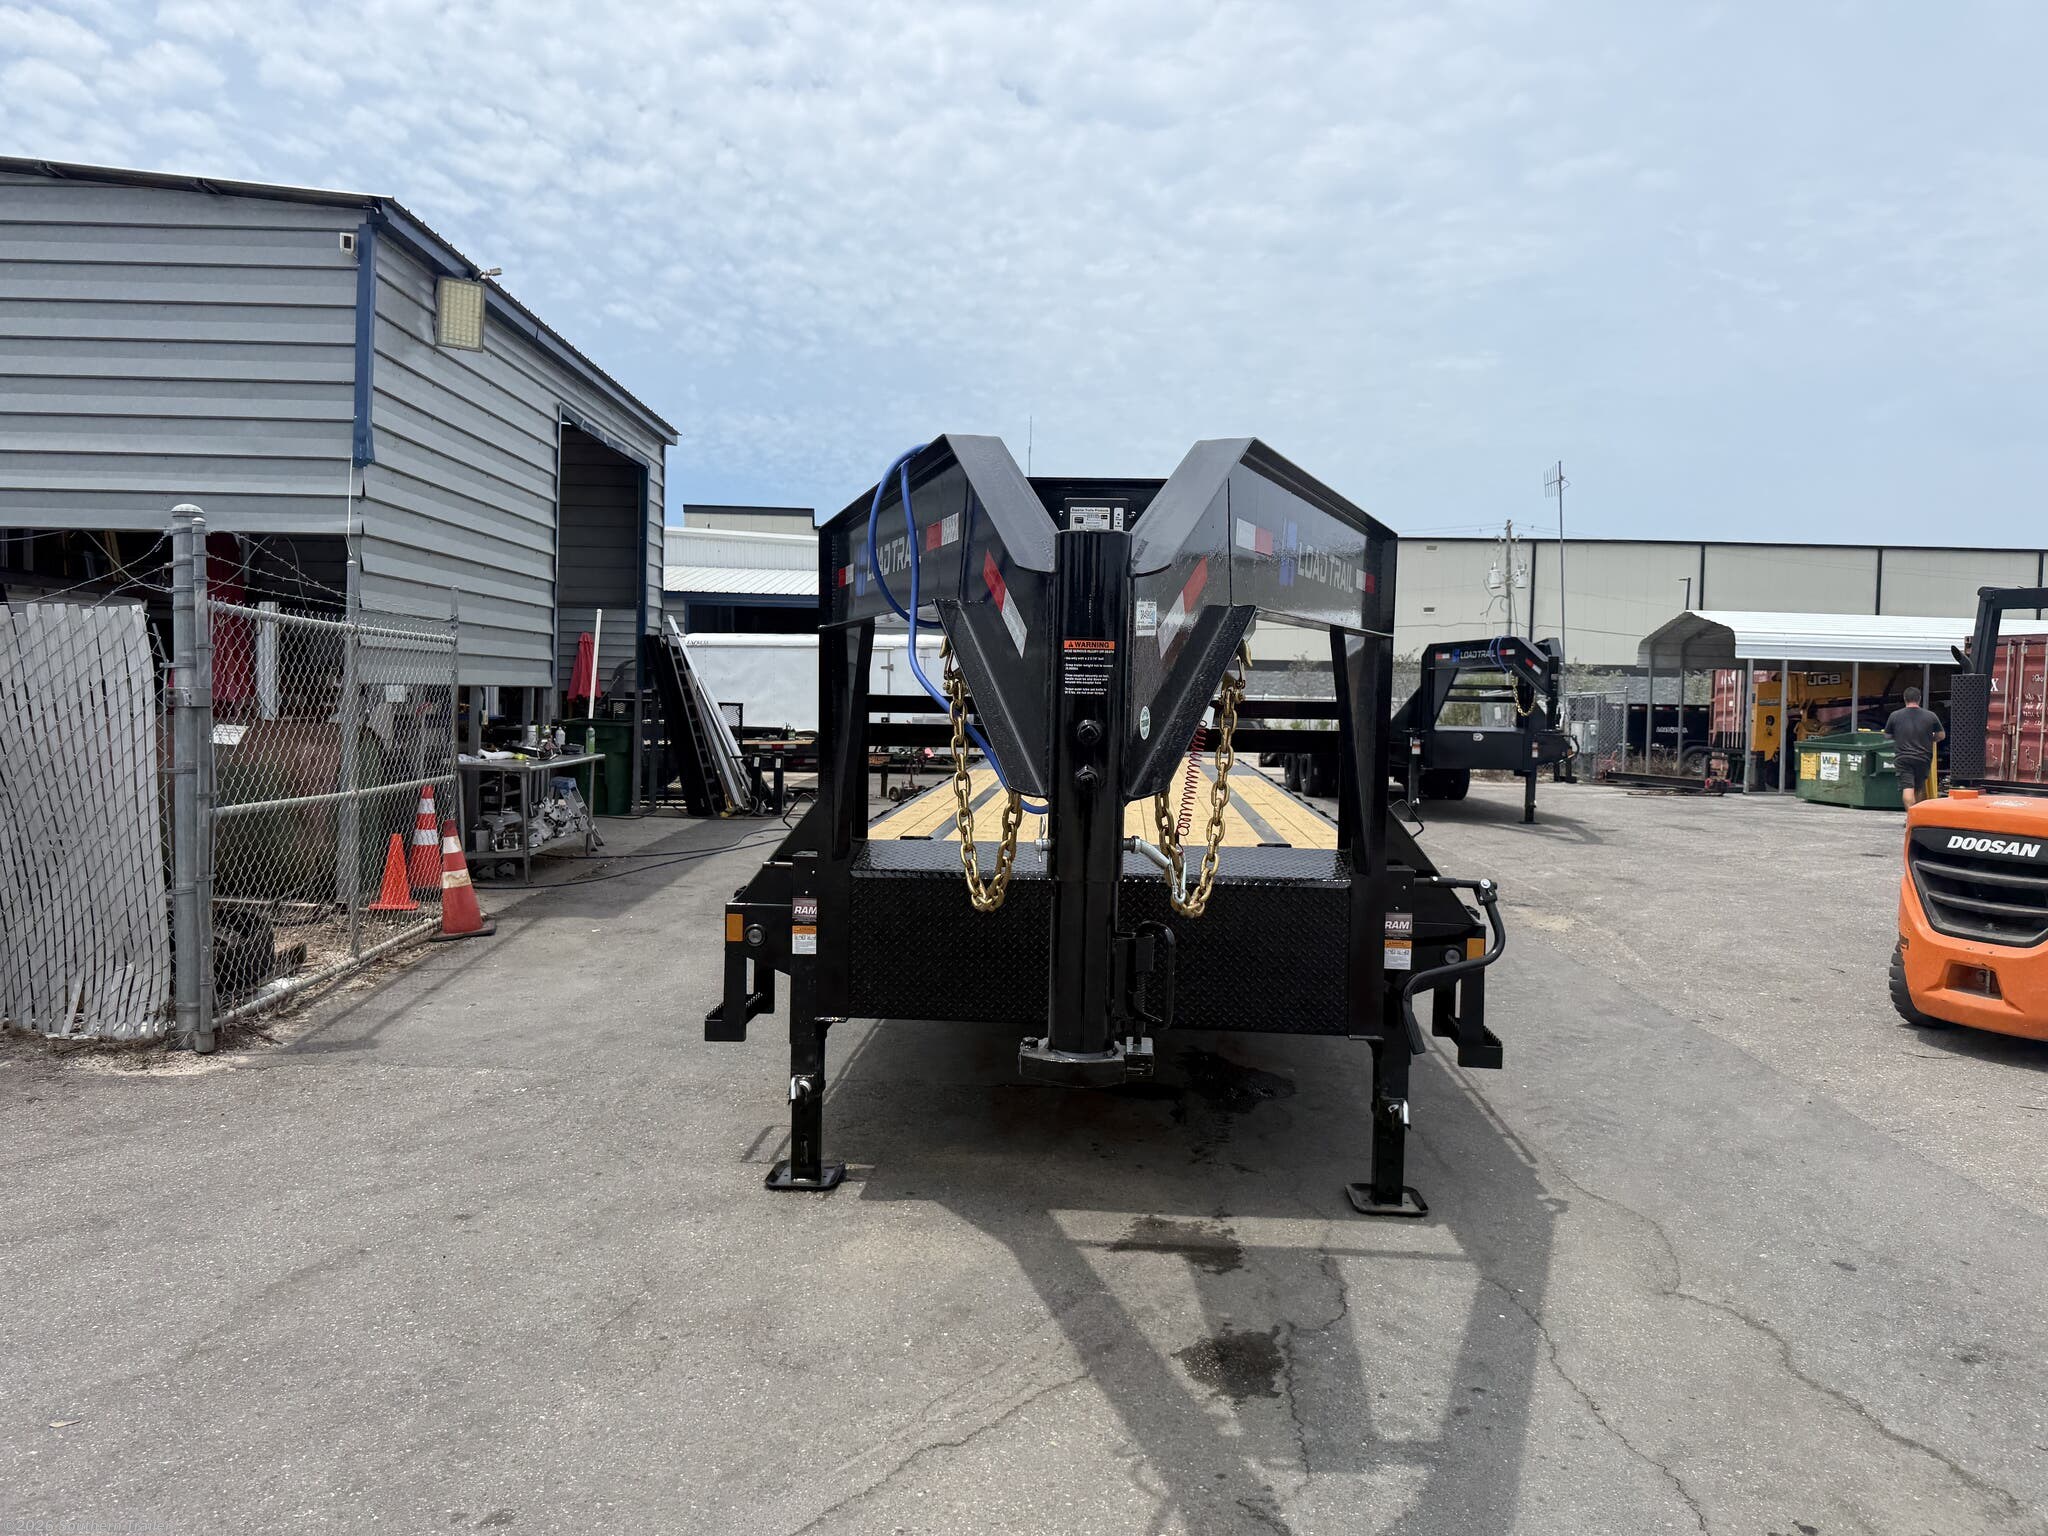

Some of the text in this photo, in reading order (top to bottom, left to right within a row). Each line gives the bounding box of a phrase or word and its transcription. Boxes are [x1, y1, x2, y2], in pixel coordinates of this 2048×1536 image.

[1075, 641, 1110, 649] WARNING
[1808, 674, 1841, 685] JCB
[1947, 835, 2041, 858] DOOSAN
[794, 905, 817, 915] RAM
[1385, 920, 1410, 930] RAM
